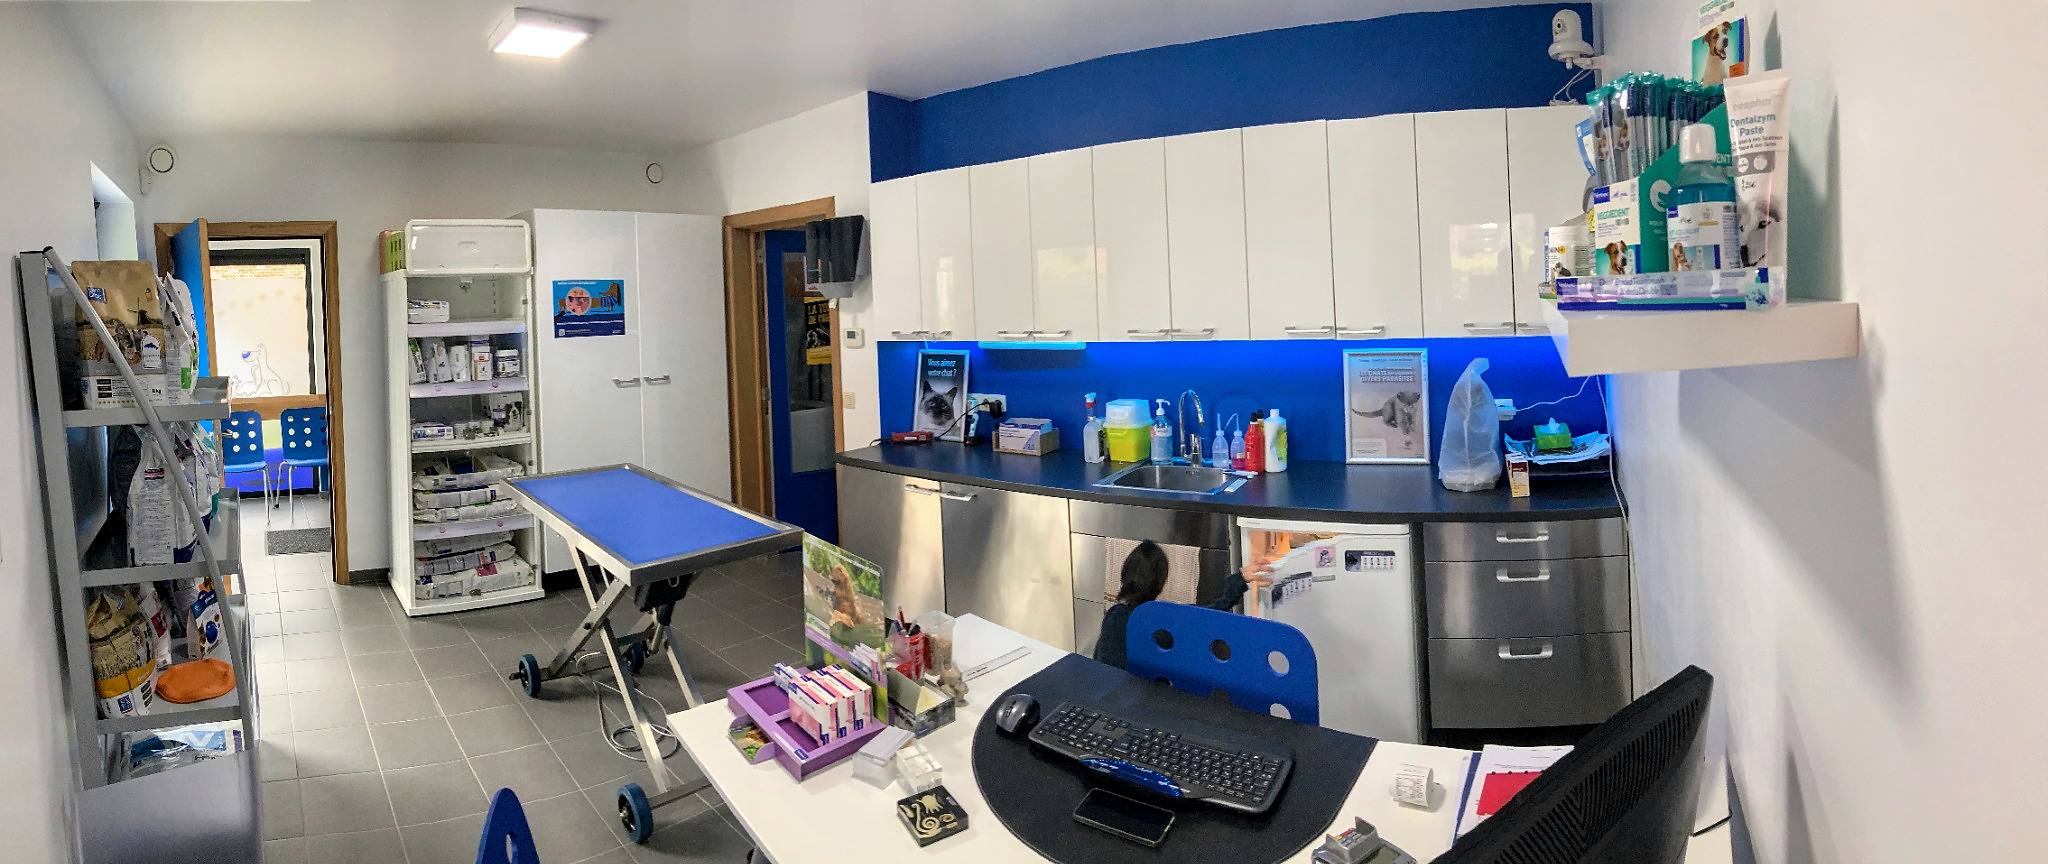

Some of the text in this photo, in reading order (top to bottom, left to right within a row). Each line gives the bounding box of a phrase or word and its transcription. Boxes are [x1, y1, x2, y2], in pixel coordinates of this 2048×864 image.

[1730, 114, 1776, 128] Dentalzym
[1739, 126, 1765, 137] Paste
[927, 358, 957, 367] Vous aimez
